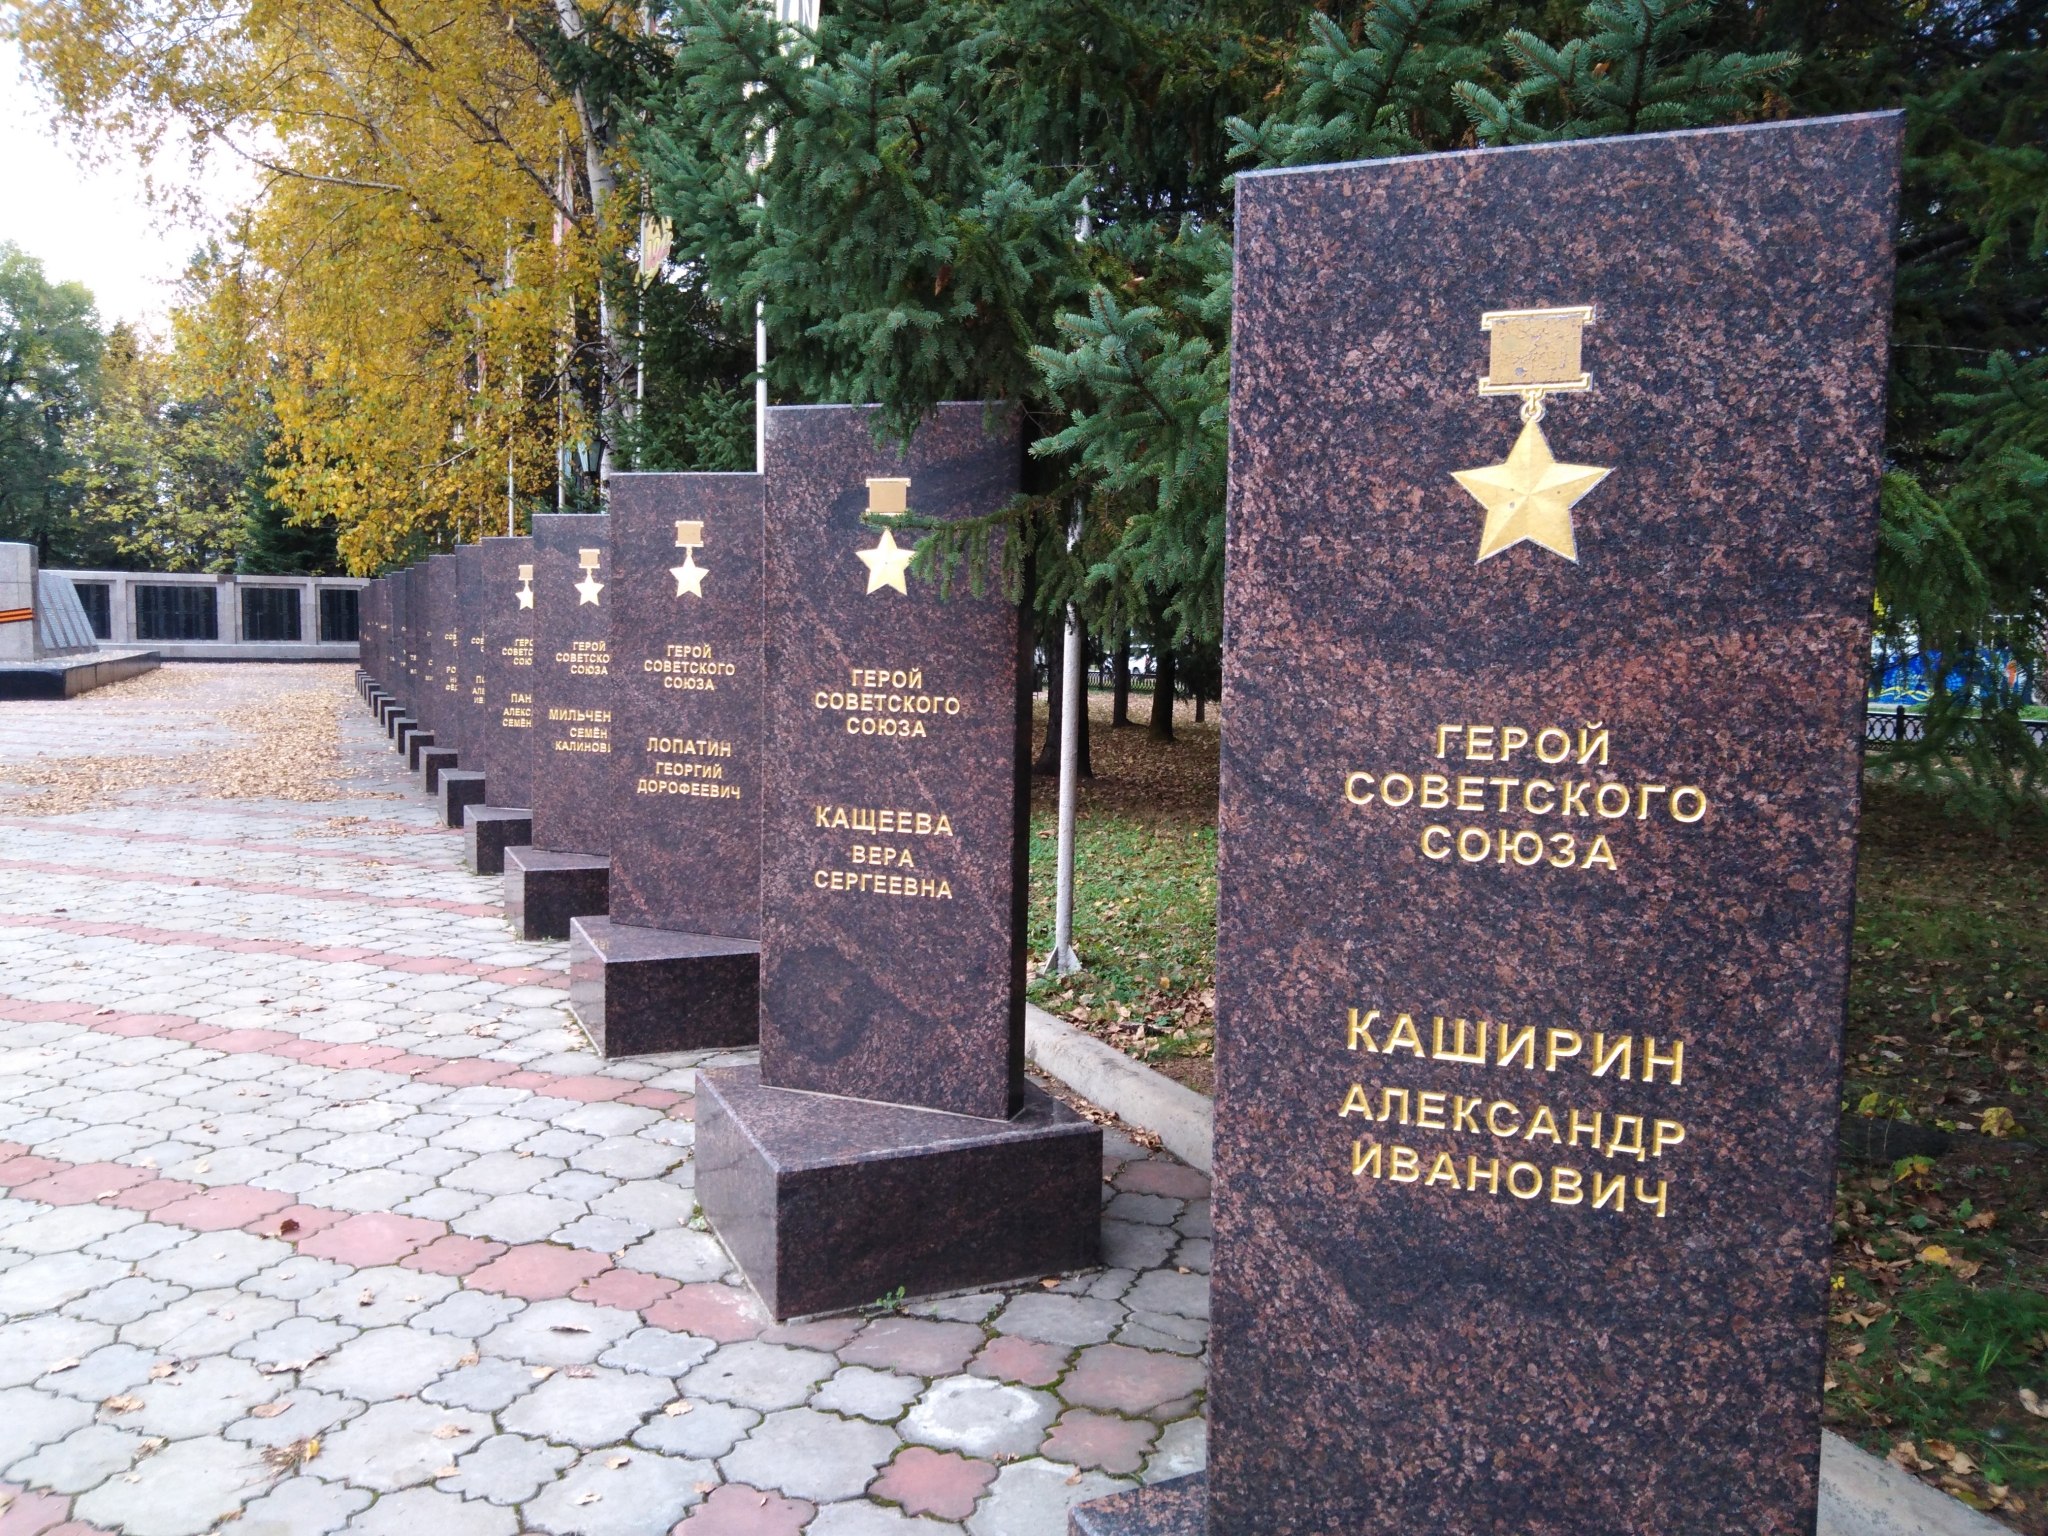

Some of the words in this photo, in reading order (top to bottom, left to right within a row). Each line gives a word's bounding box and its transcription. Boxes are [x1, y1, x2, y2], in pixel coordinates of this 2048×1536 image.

[502, 647, 534, 656] СОВЕТС
[572, 640, 606, 652] ГЕРОЙ
[666, 644, 712, 659] ГЕРОЙ
[513, 657, 533, 666] СОЮ
[555, 652, 610, 664] СОВЕТСКО
[644, 659, 736, 676] СОВЕТСКОГО
[570, 665, 609, 675] СОЮЗА
[851, 668, 923, 689] ГЕРОЙ
[664, 676, 715, 691] СОЮЗА
[510, 693, 532, 703] ПАН
[814, 691, 961, 715] СОВЕТСКОГО
[503, 707, 533, 717] АЛЕКС
[548, 708, 612, 722] МИЛЬЧЕН
[502, 718, 532, 728] СЕМЁН
[846, 716, 927, 738] СОЮЗА
[569, 727, 608, 739] СЕМЁН
[646, 737, 732, 757] ЛОПАТИН
[1436, 721, 1610, 767] ГЕРОЙ
[655, 761, 723, 779] ГЕОРГИЙ
[636, 779, 741, 799] ДОРОФЕЕВИЧ
[1344, 771, 1707, 823] СОВЕТСКОГО
[815, 805, 954, 836] КАЩЕЕВА
[852, 845, 915, 868] ВЕРА
[1420, 824, 1618, 871] СОЮЗА
[814, 869, 953, 899] СЕРГЕЕВНА
[1346, 1007, 1684, 1086] КАШИРИН
[1338, 1082, 1686, 1161] АЛЕКСАНДР
[1351, 1139, 1669, 1218] ИВАНОВИЧ
